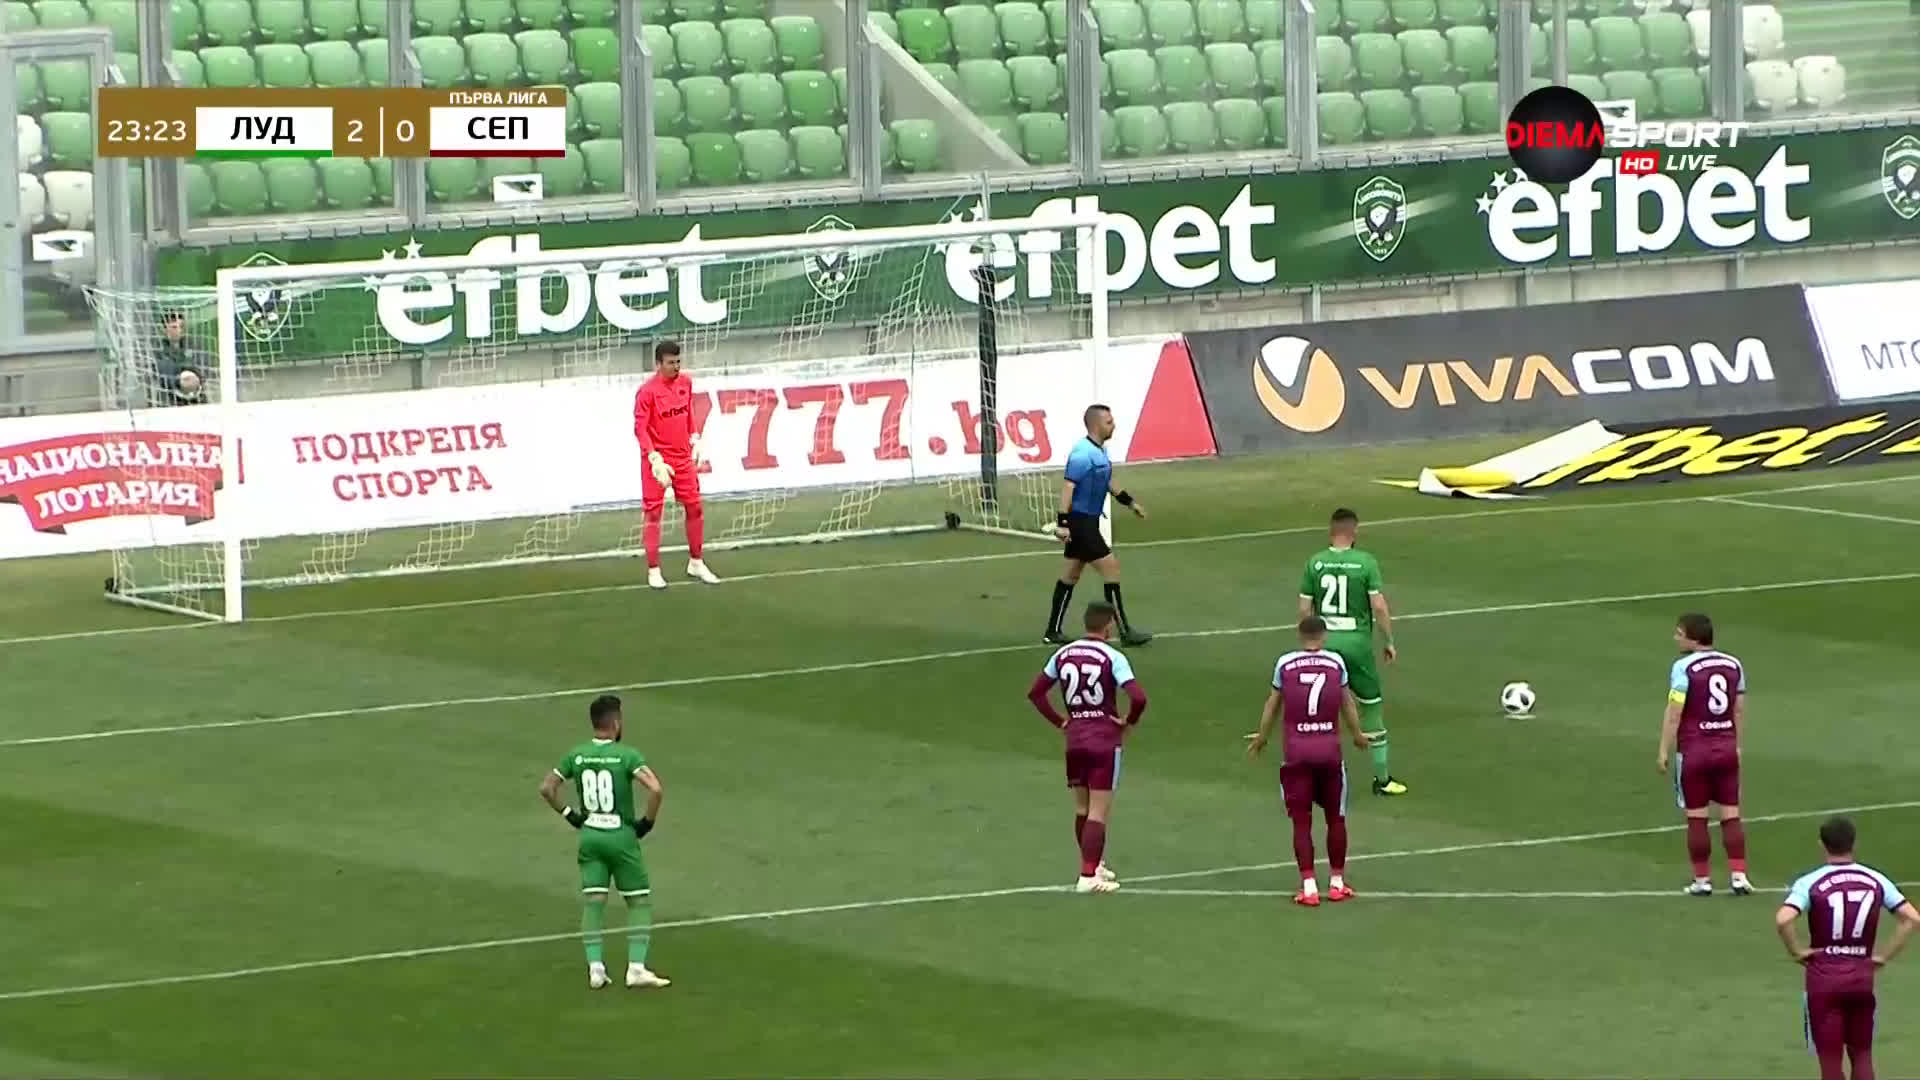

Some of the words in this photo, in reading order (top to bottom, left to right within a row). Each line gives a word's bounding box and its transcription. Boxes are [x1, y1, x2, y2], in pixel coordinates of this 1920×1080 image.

[1488, 144, 1812, 263] efbet
[945, 183, 1276, 304] efbet
[376, 223, 728, 345] efbet
[1357, 337, 1775, 410] VIVACOM
[291, 422, 508, 465] ПОДКРЕПЯ
[1521, 411, 1888, 489] fbet
[34, 480, 201, 518] ЛОТАРИЯ
[332, 464, 493, 502] СПОРТА
[1320, 573, 1348, 614] 21
[1060, 662, 1104, 706] 23
[1299, 672, 1326, 716] 7
[581, 768, 615, 813] 88
[1827, 888, 1875, 941] 17
